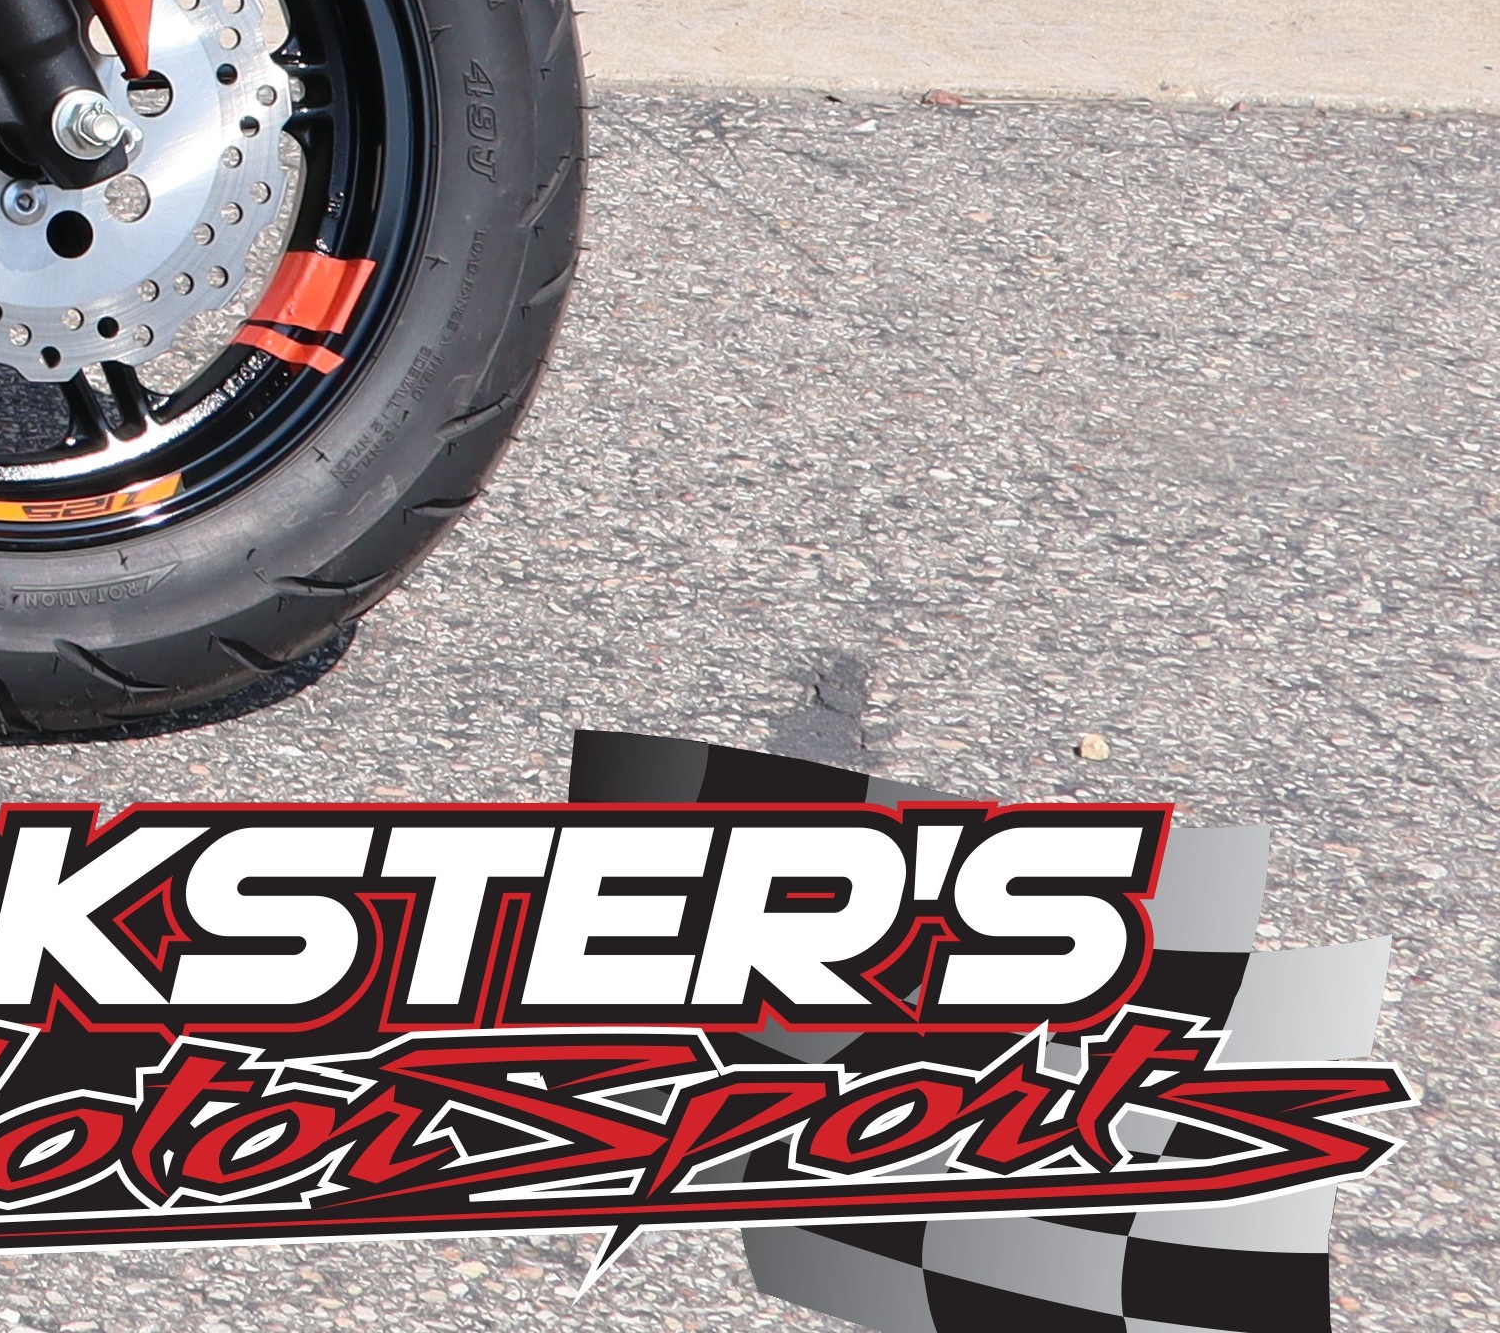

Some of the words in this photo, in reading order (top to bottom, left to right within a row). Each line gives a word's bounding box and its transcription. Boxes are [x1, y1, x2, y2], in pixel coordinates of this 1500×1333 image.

[462, 56, 498, 182] 49J
[21, 493, 140, 520] Z125
[24, 580, 141, 607] ROTATION
